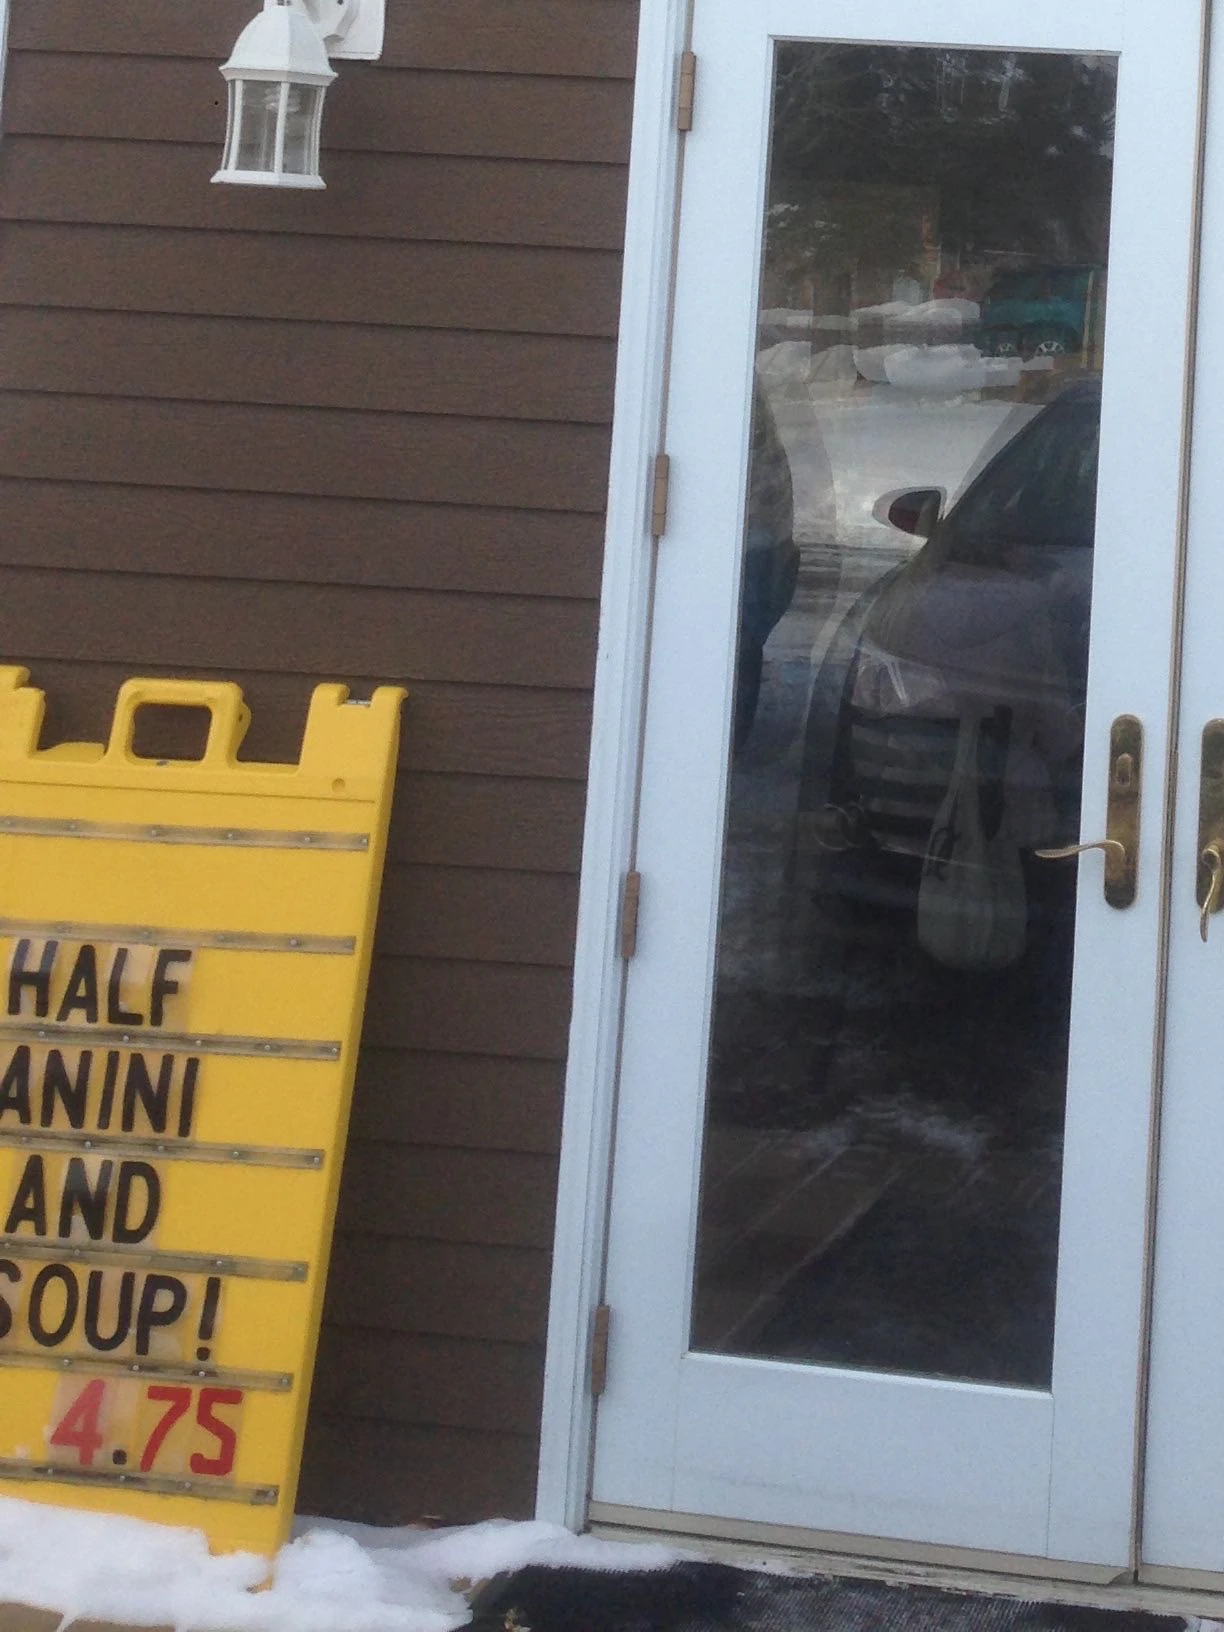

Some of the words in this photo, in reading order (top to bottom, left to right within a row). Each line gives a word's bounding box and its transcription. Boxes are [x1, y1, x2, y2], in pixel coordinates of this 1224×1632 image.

[8, 938, 193, 1028] HALF
[5, 1154, 161, 1244] AND
[50, 1379, 244, 1476] 4.75
